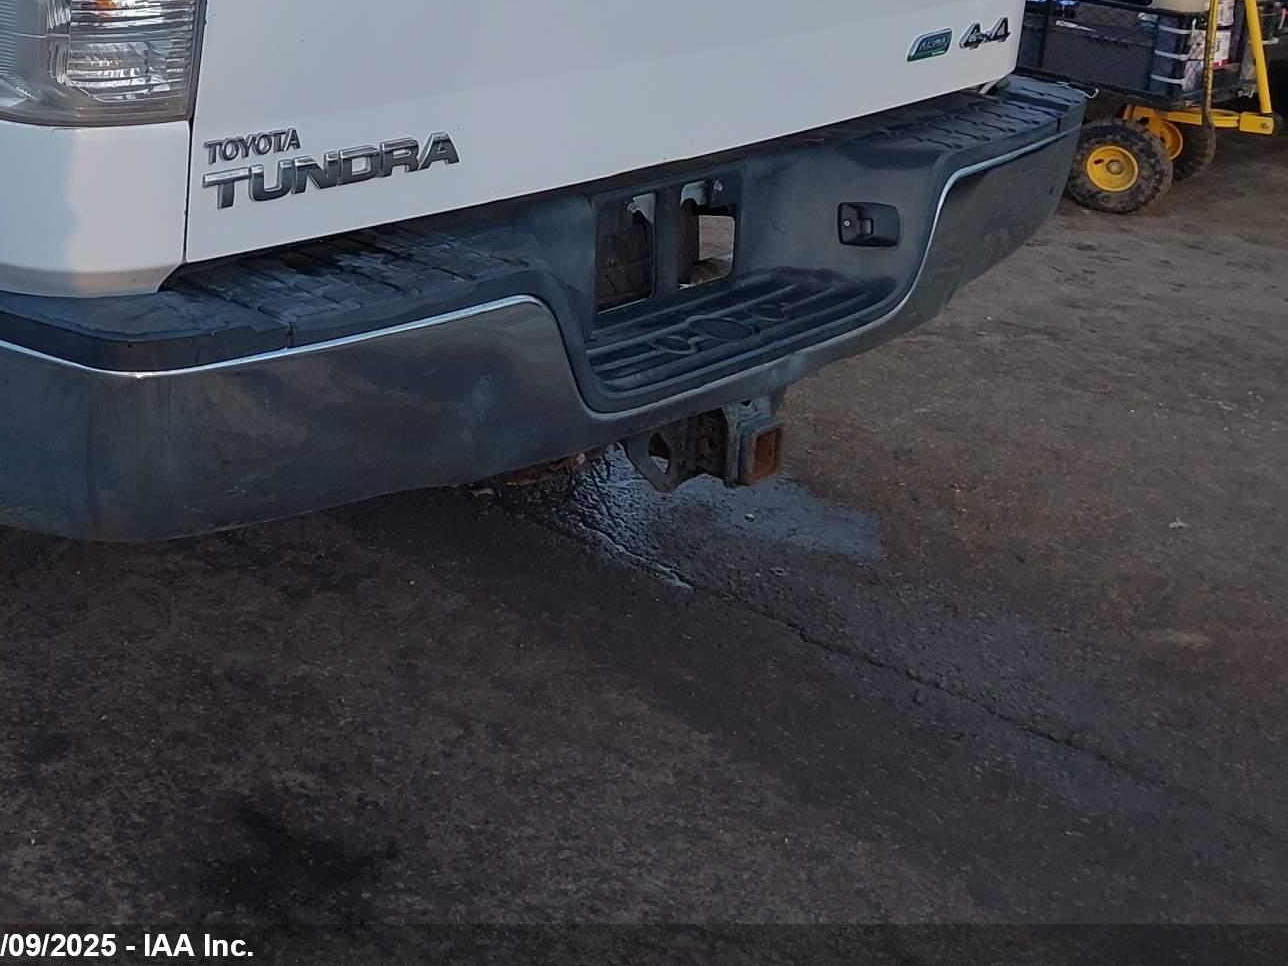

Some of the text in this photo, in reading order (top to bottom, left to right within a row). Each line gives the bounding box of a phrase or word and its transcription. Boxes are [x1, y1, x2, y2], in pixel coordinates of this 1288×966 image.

[959, 17, 1011, 50] 4x4
[203, 127, 302, 165] TOYOTA
[202, 131, 461, 210] TUNDRA
